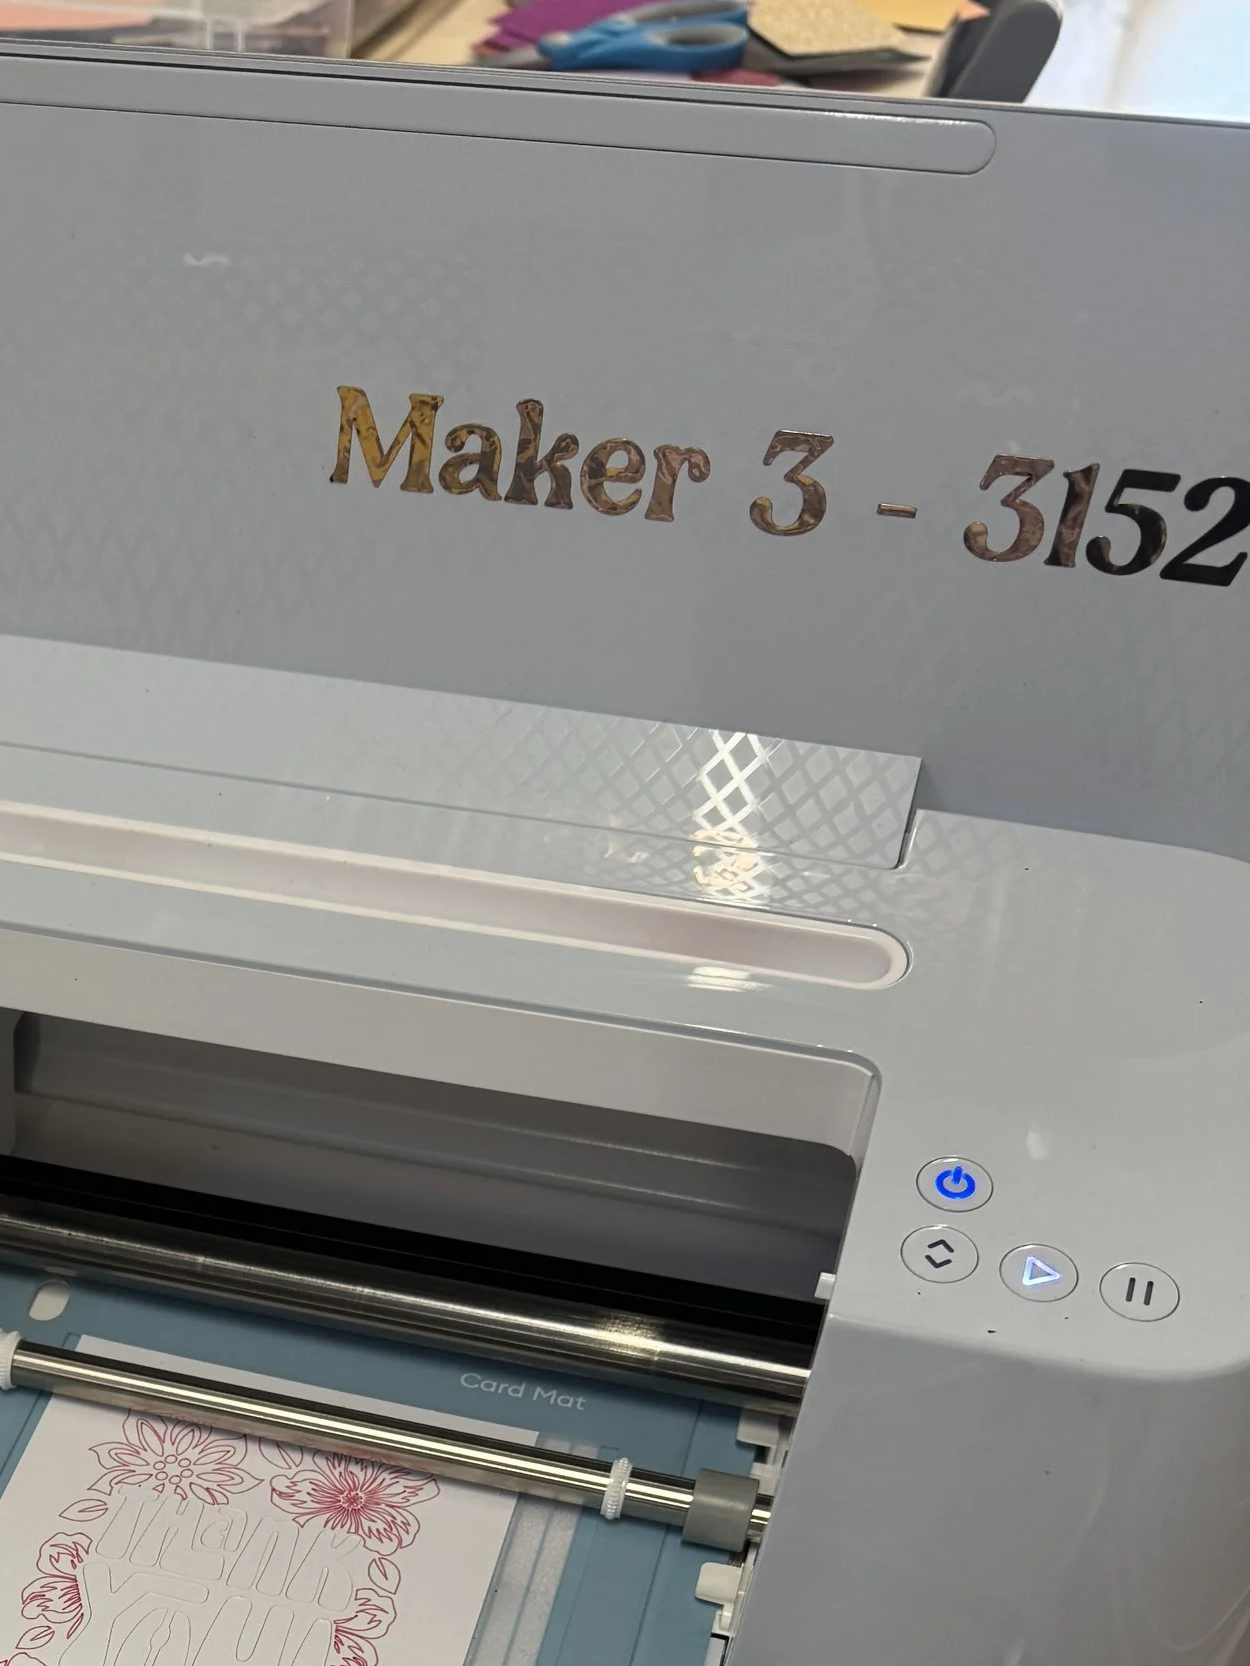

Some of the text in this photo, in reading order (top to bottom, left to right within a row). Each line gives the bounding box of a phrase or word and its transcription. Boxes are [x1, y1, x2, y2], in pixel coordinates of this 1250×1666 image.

[330, 384, 711, 523] Maker
[750, 429, 835, 537] 3
[961, 453, 1250, 588] 3152
[460, 1372, 587, 1411] Card Mat
